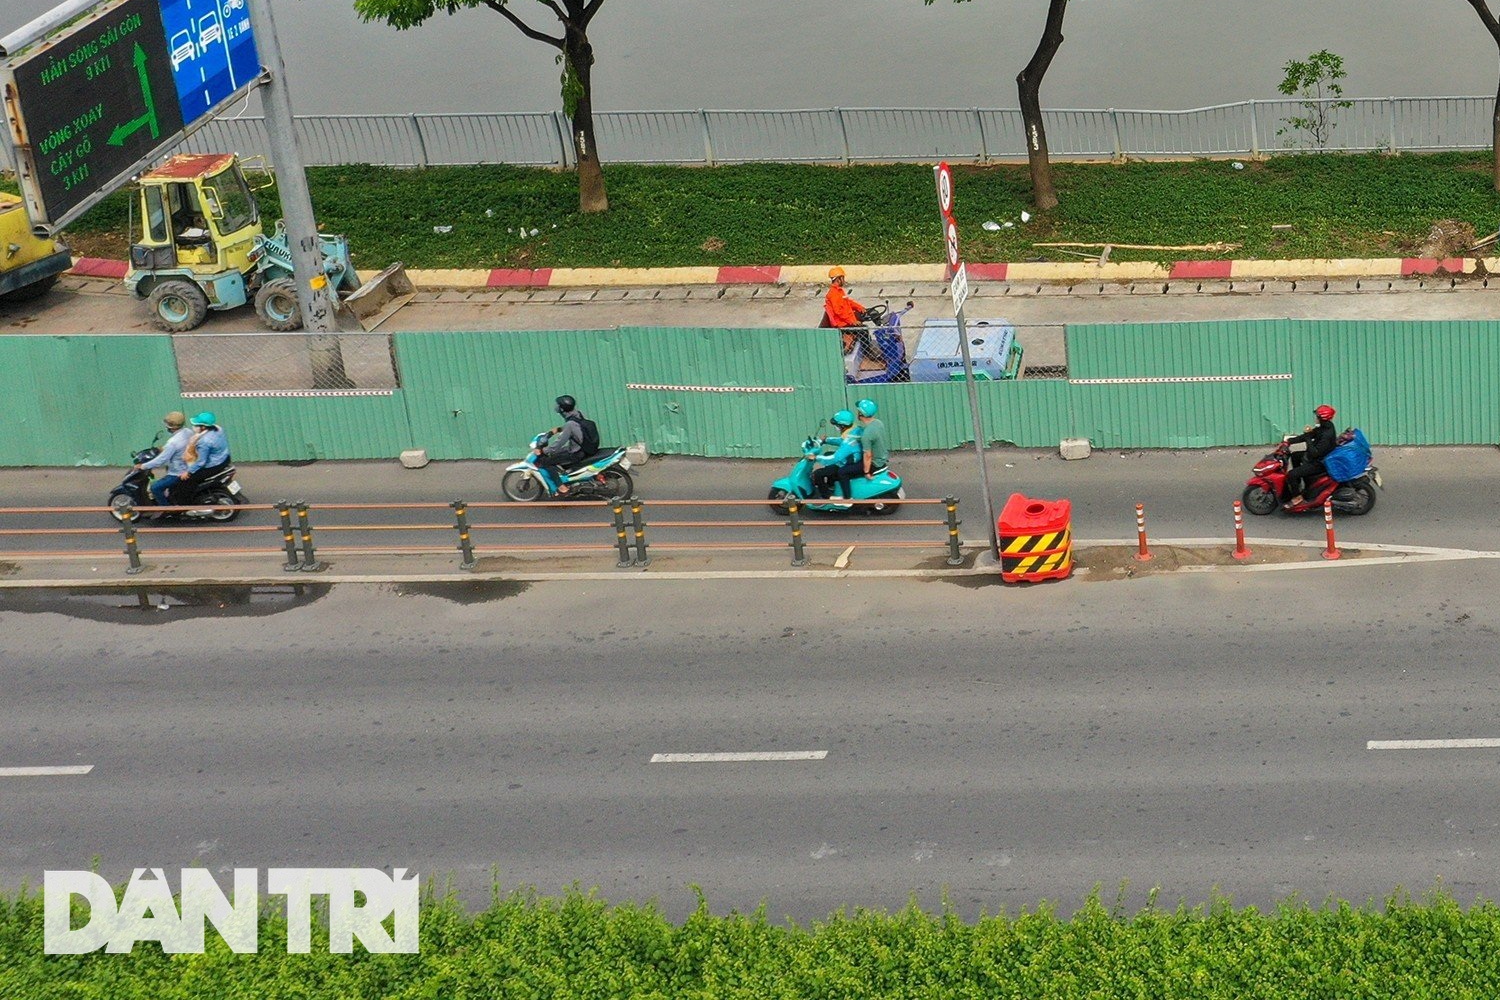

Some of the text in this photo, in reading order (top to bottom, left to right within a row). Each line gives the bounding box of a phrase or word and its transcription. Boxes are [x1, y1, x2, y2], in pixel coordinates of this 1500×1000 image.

[86, 55, 111, 80] 9 KM
[63, 163, 89, 191] 3 KM
